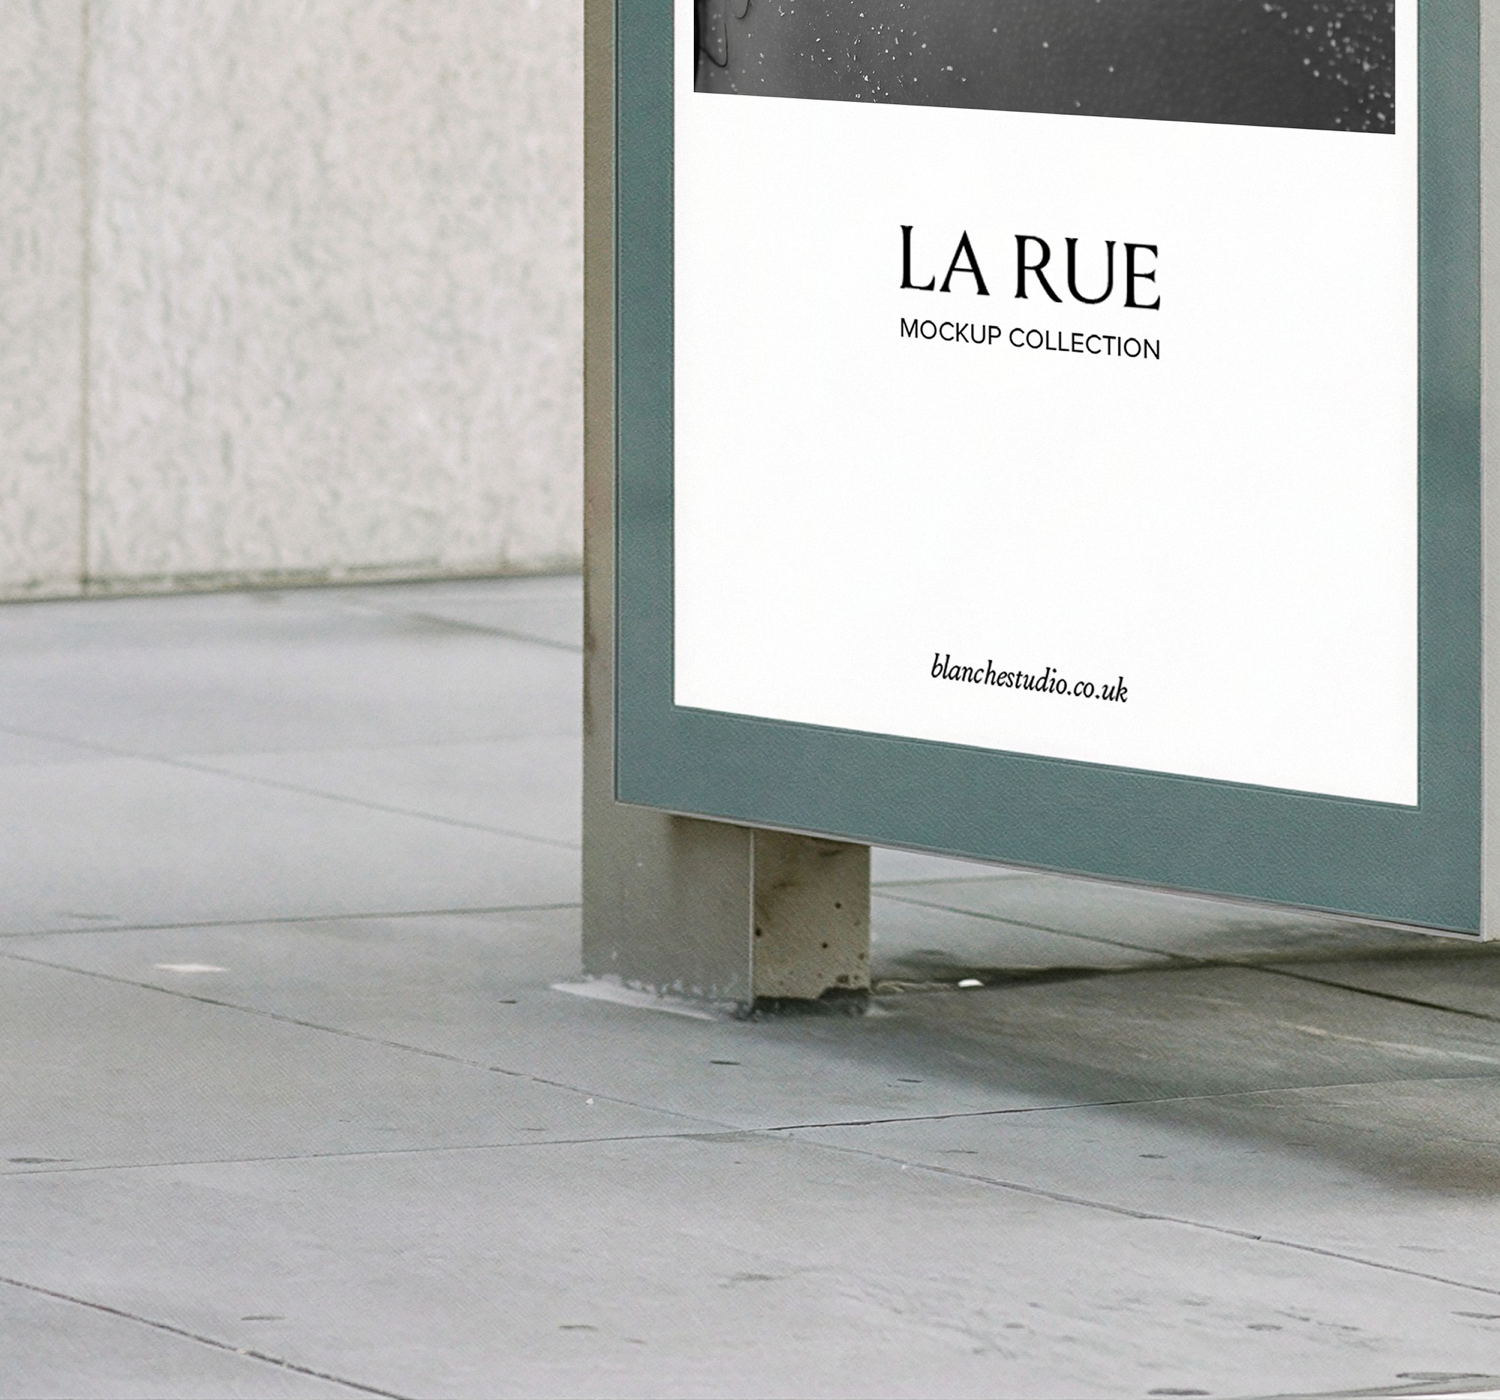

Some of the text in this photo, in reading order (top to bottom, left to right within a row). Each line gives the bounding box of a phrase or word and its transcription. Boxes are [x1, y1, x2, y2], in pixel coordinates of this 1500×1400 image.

[900, 225, 1160, 310] LA RUE
[901, 318, 1159, 359] MOCKUP COLLECTION
[931, 653, 1127, 702] blanchestudio.co.uk
